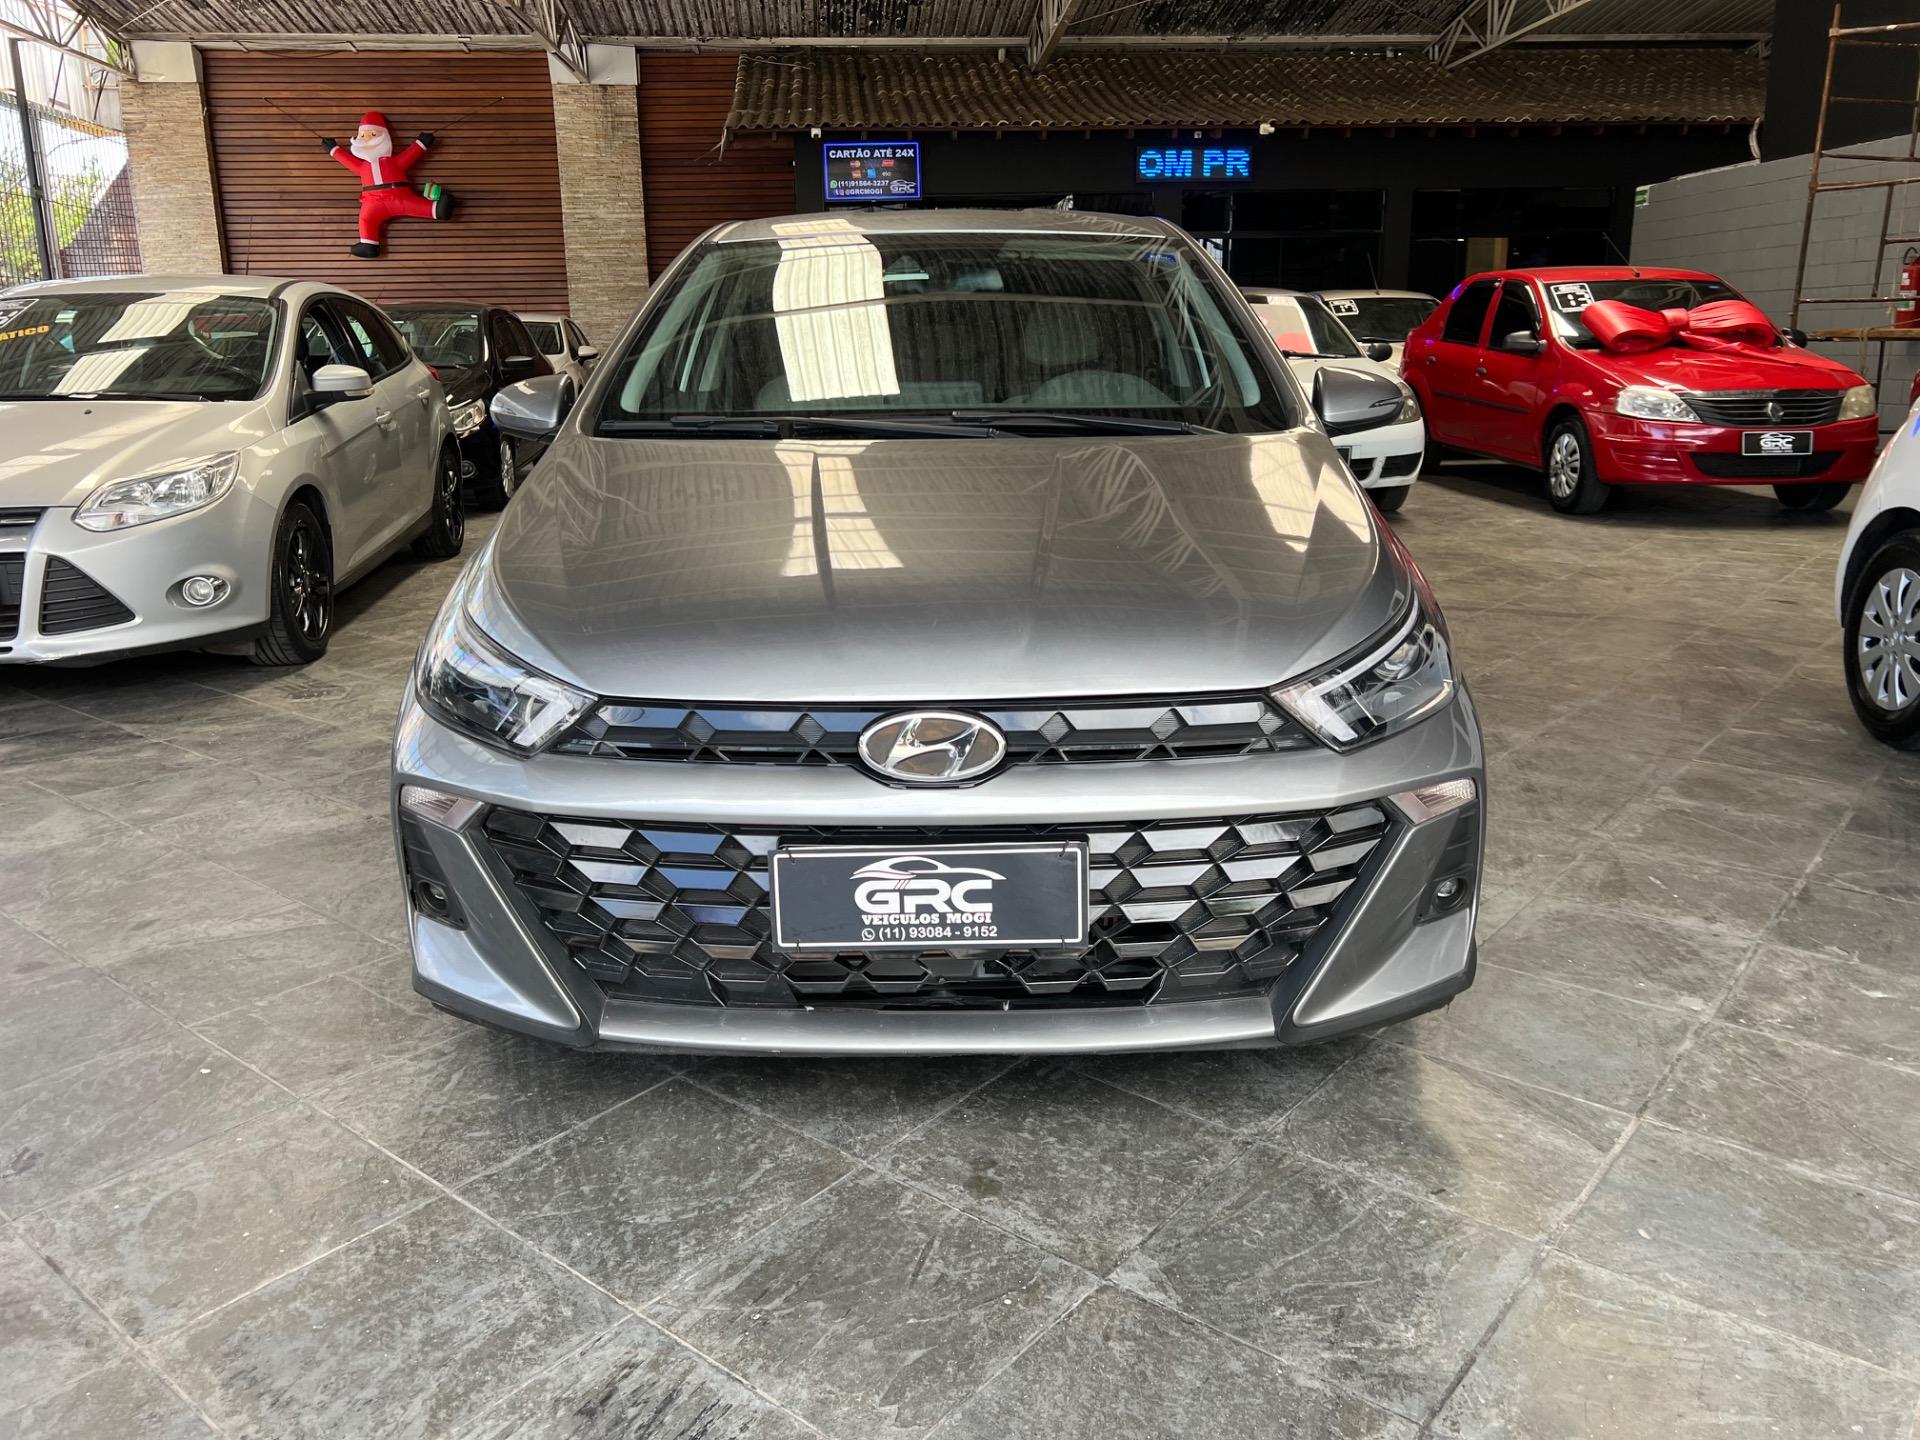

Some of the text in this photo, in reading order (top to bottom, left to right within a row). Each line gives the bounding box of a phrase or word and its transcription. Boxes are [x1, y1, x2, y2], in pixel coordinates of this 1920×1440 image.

[829, 147, 915, 158] CARTÃO ATÉ 24X
[1139, 150, 1250, 177] OM PR
[1760, 438, 1793, 448] GRC
[854, 879, 993, 914] GRC
[861, 912, 992, 925] VEICULOS MOGI
[878, 927, 906, 941] (11)
[909, 927, 951, 938] 93084
[963, 926, 998, 938] 9152
